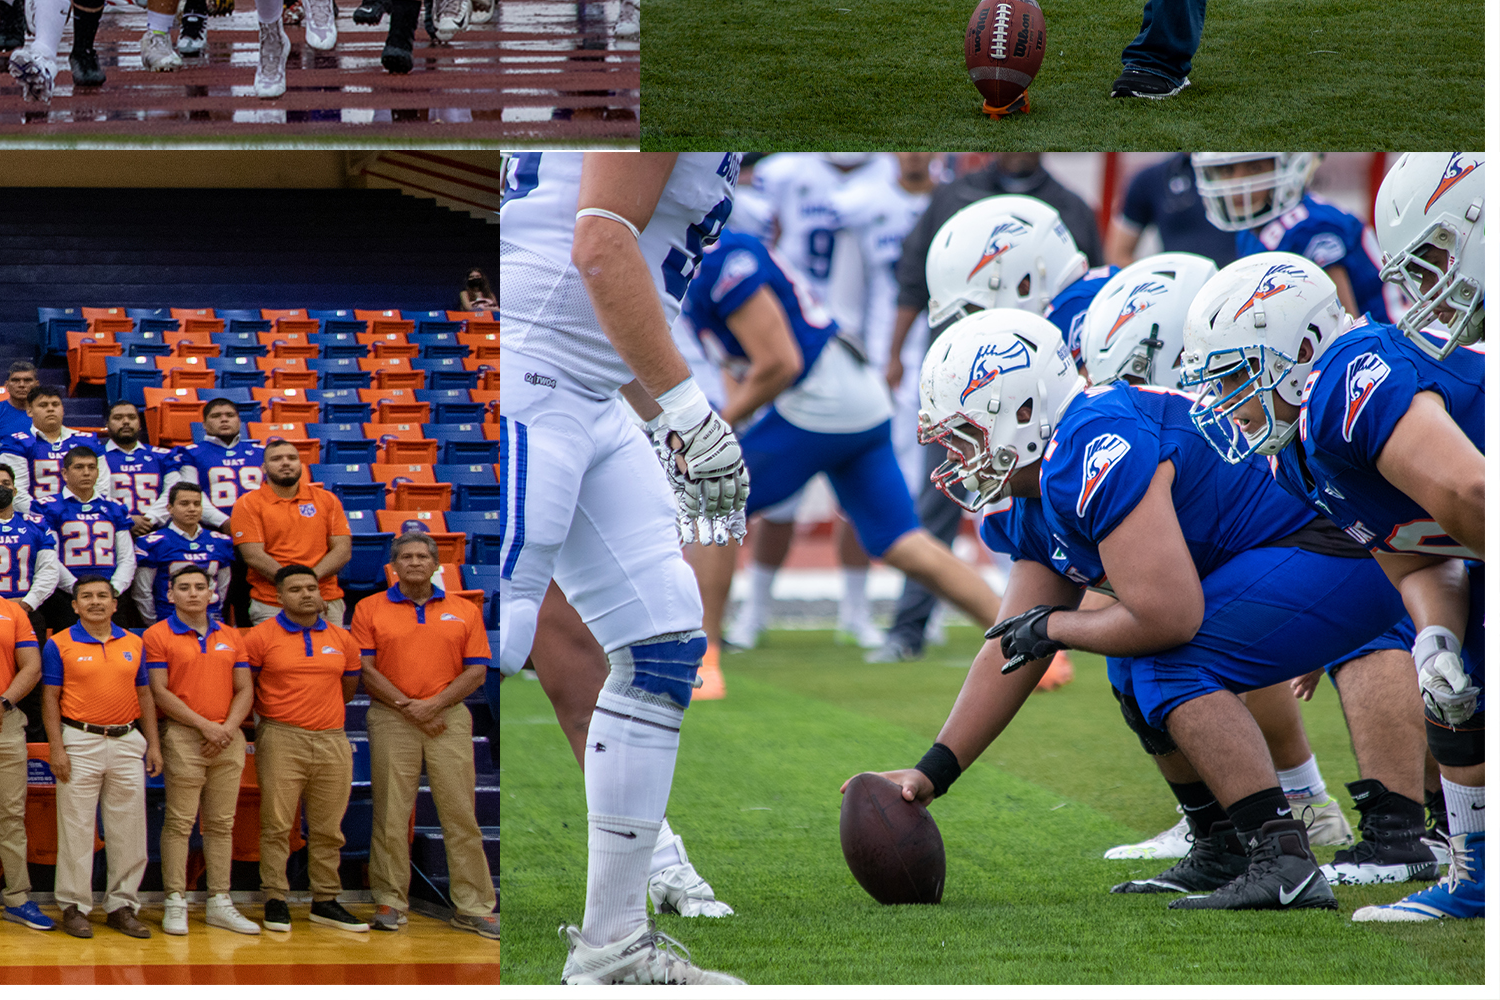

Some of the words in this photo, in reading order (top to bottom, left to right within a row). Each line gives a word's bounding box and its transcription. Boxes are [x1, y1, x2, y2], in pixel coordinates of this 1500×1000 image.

[1012, 12, 1030, 58] Wilson
[810, 228, 835, 279] 9
[119, 463, 144, 472] UAT
[222, 458, 246, 466] UAT
[109, 472, 160, 516] 65
[207, 465, 264, 508] 69
[76, 513, 100, 521] UAT
[61, 520, 116, 567] 22
[183, 552, 208, 561] UAT
